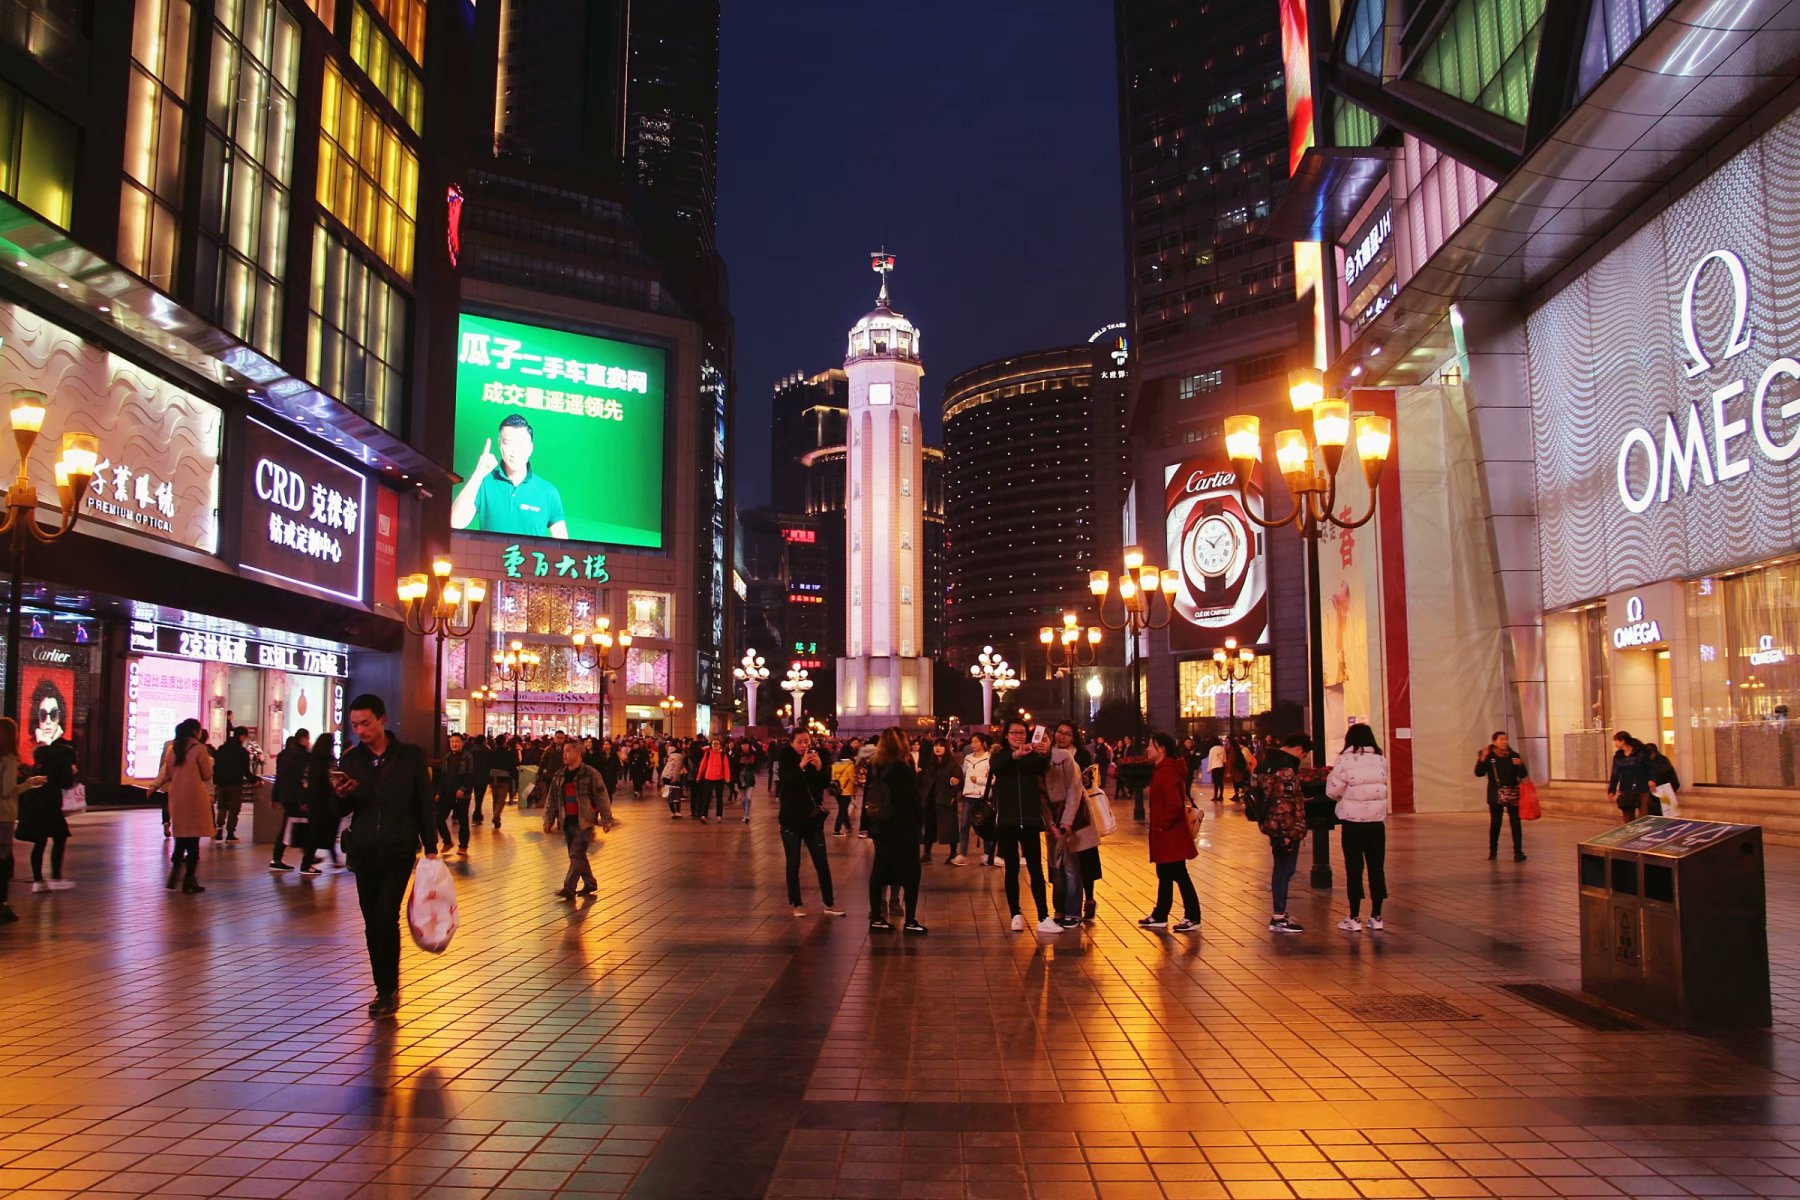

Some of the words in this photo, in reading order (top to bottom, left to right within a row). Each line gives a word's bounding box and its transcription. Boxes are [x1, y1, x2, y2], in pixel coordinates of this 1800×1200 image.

[459, 332, 648, 394] 瓜子二手车直卖网
[1101, 370, 1128, 379] 大世界
[482, 381, 623, 421] 成交量遥遥领先
[255, 458, 306, 512] CRD
[1186, 470, 1236, 493] Cartier
[88, 497, 133, 520] PREMIUM
[135, 512, 173, 533] OPTICAL
[269, 512, 342, 563] 钻戒定制中心
[503, 544, 610, 583] 重百大楼
[576, 601, 590, 618] 开
[1614, 620, 1661, 648] OMEGA
[33, 645, 71, 662] Cartier
[1750, 649, 1785, 665] OMEGA
[129, 662, 139, 699] CRD
[1196, 674, 1254, 698] Cartier
[334, 685, 343, 724] CRD
